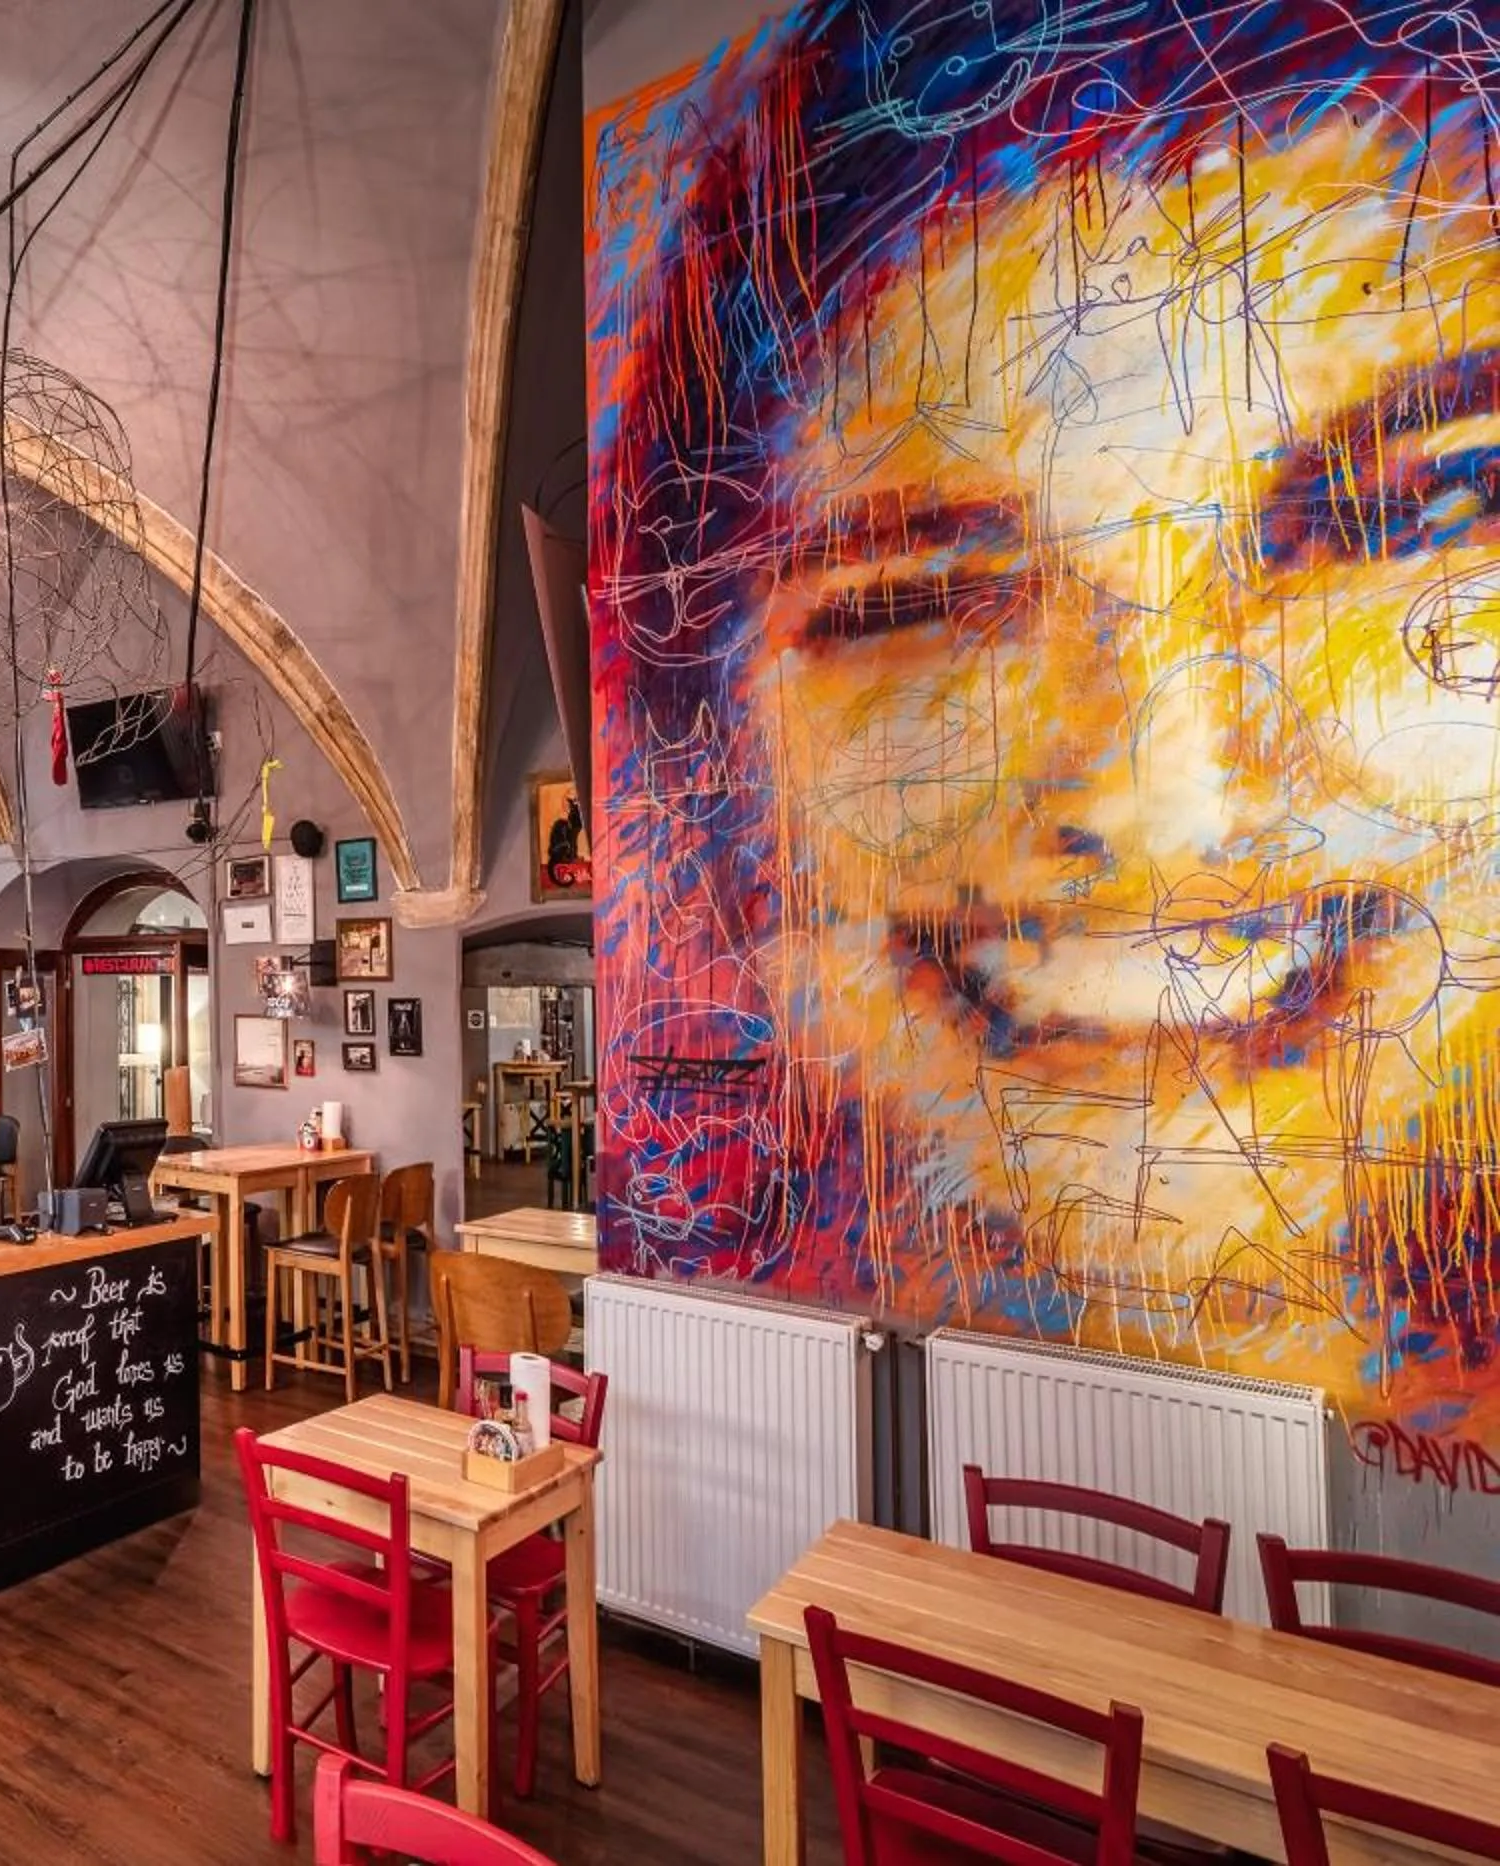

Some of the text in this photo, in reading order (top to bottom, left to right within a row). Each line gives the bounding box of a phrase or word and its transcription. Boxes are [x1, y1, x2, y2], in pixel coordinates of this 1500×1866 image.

[81, 1265, 167, 1309] Beer is
[41, 1305, 144, 1367] proof that
[51, 1361, 100, 1413] God
[30, 1412, 63, 1450] and
[80, 1393, 133, 1433] wants
[60, 1455, 85, 1481] to
[94, 1440, 113, 1473] be
